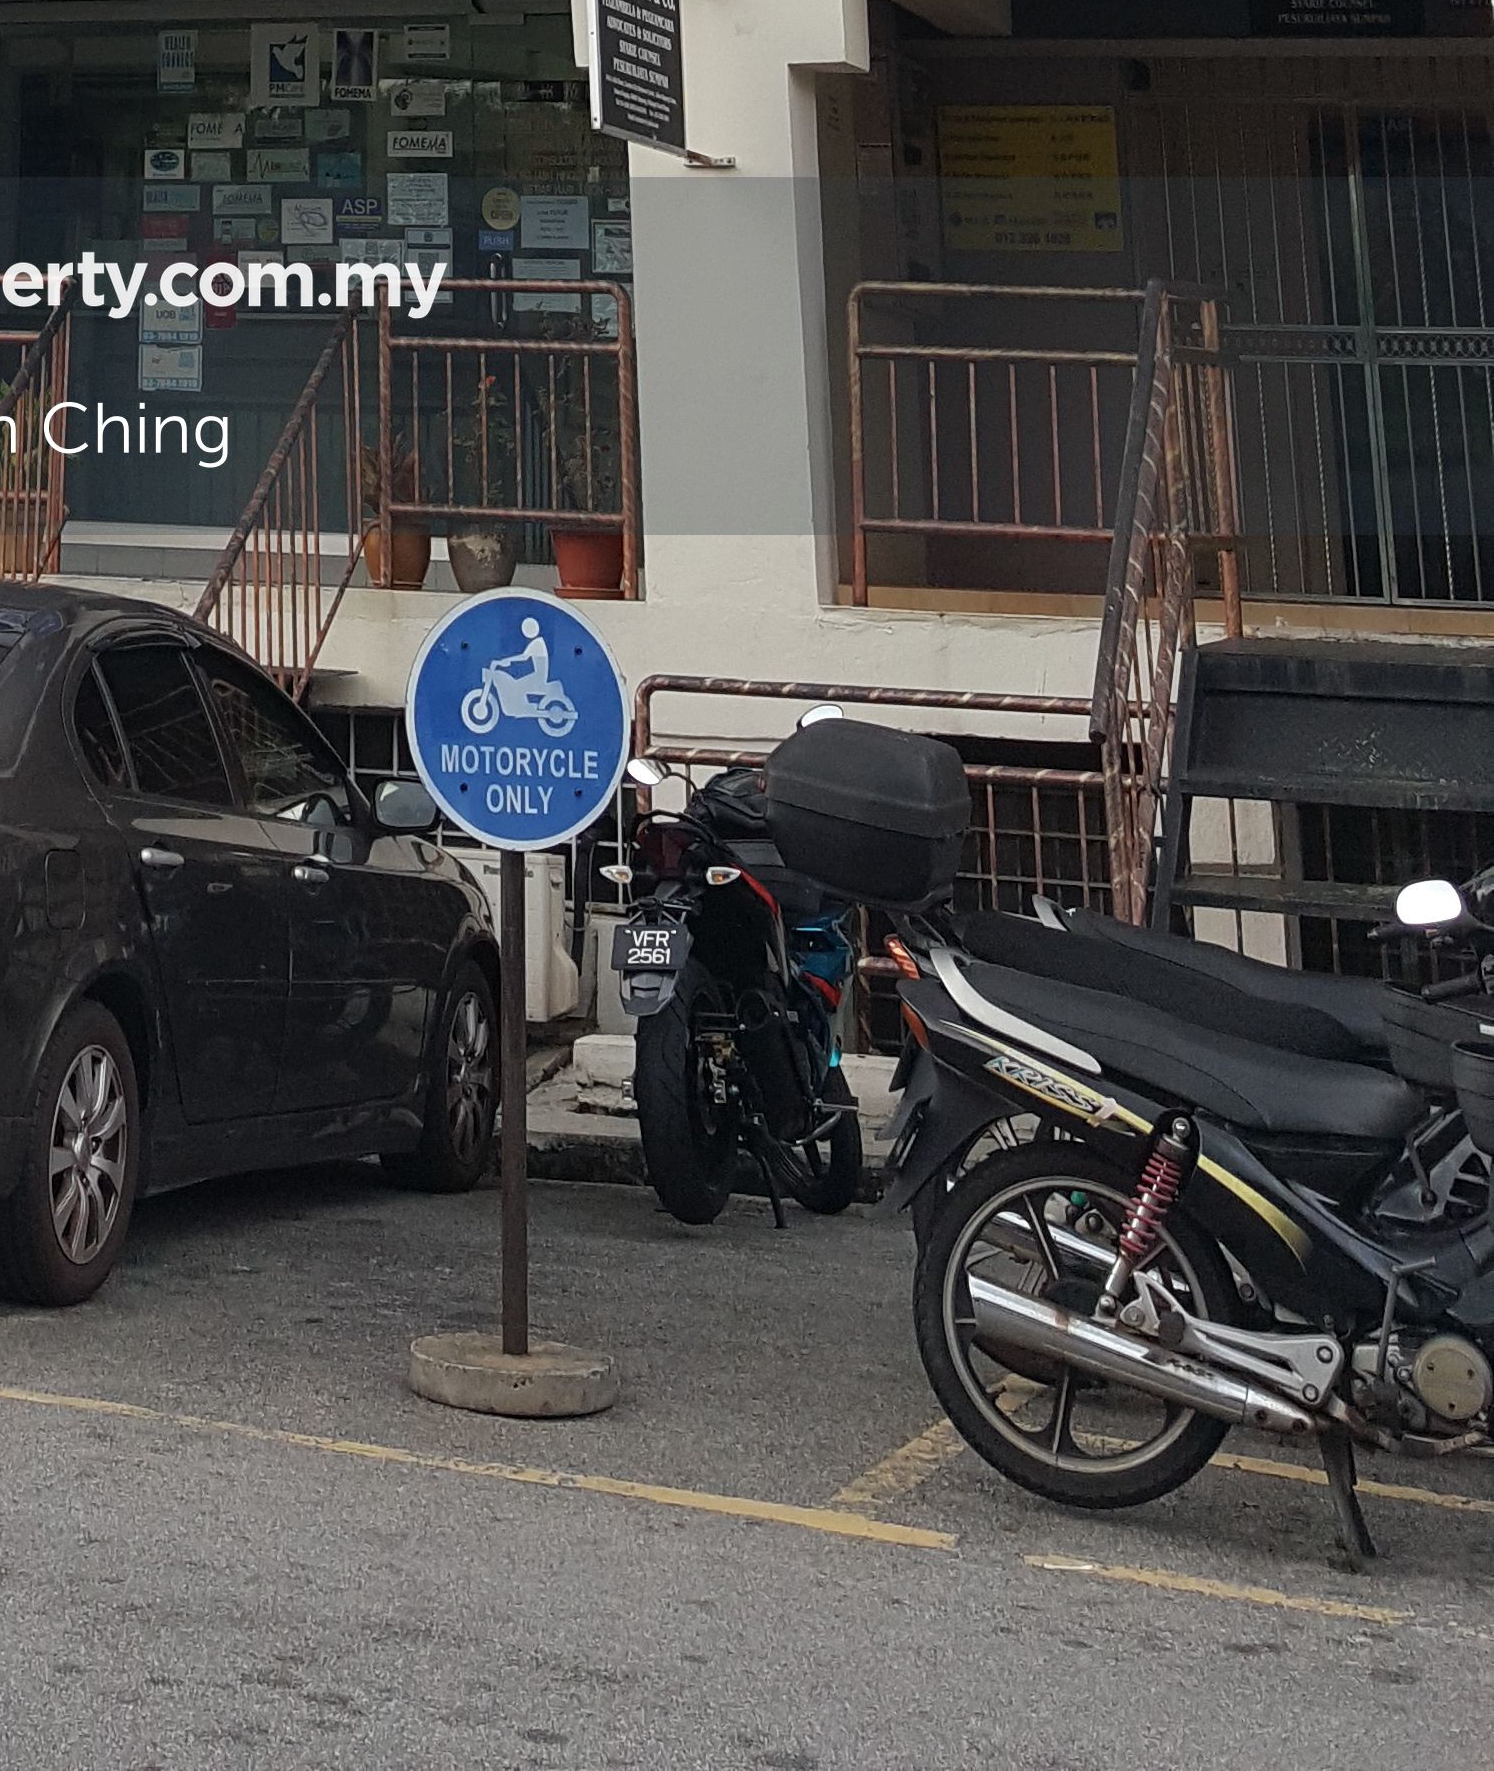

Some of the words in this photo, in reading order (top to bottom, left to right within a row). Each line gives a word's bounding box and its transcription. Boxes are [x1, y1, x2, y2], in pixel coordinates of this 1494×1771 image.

[334, 86, 372, 98] FOMEMA
[392, 136, 447, 151] FOMEMA
[342, 199, 378, 215] ASP
[441, 744, 599, 779] MOTORYCLE
[486, 784, 554, 815] ONLY
[632, 930, 670, 947] VFR
[627, 948, 671, 964] 2561
[983, 1056, 1100, 1111] KRISS
